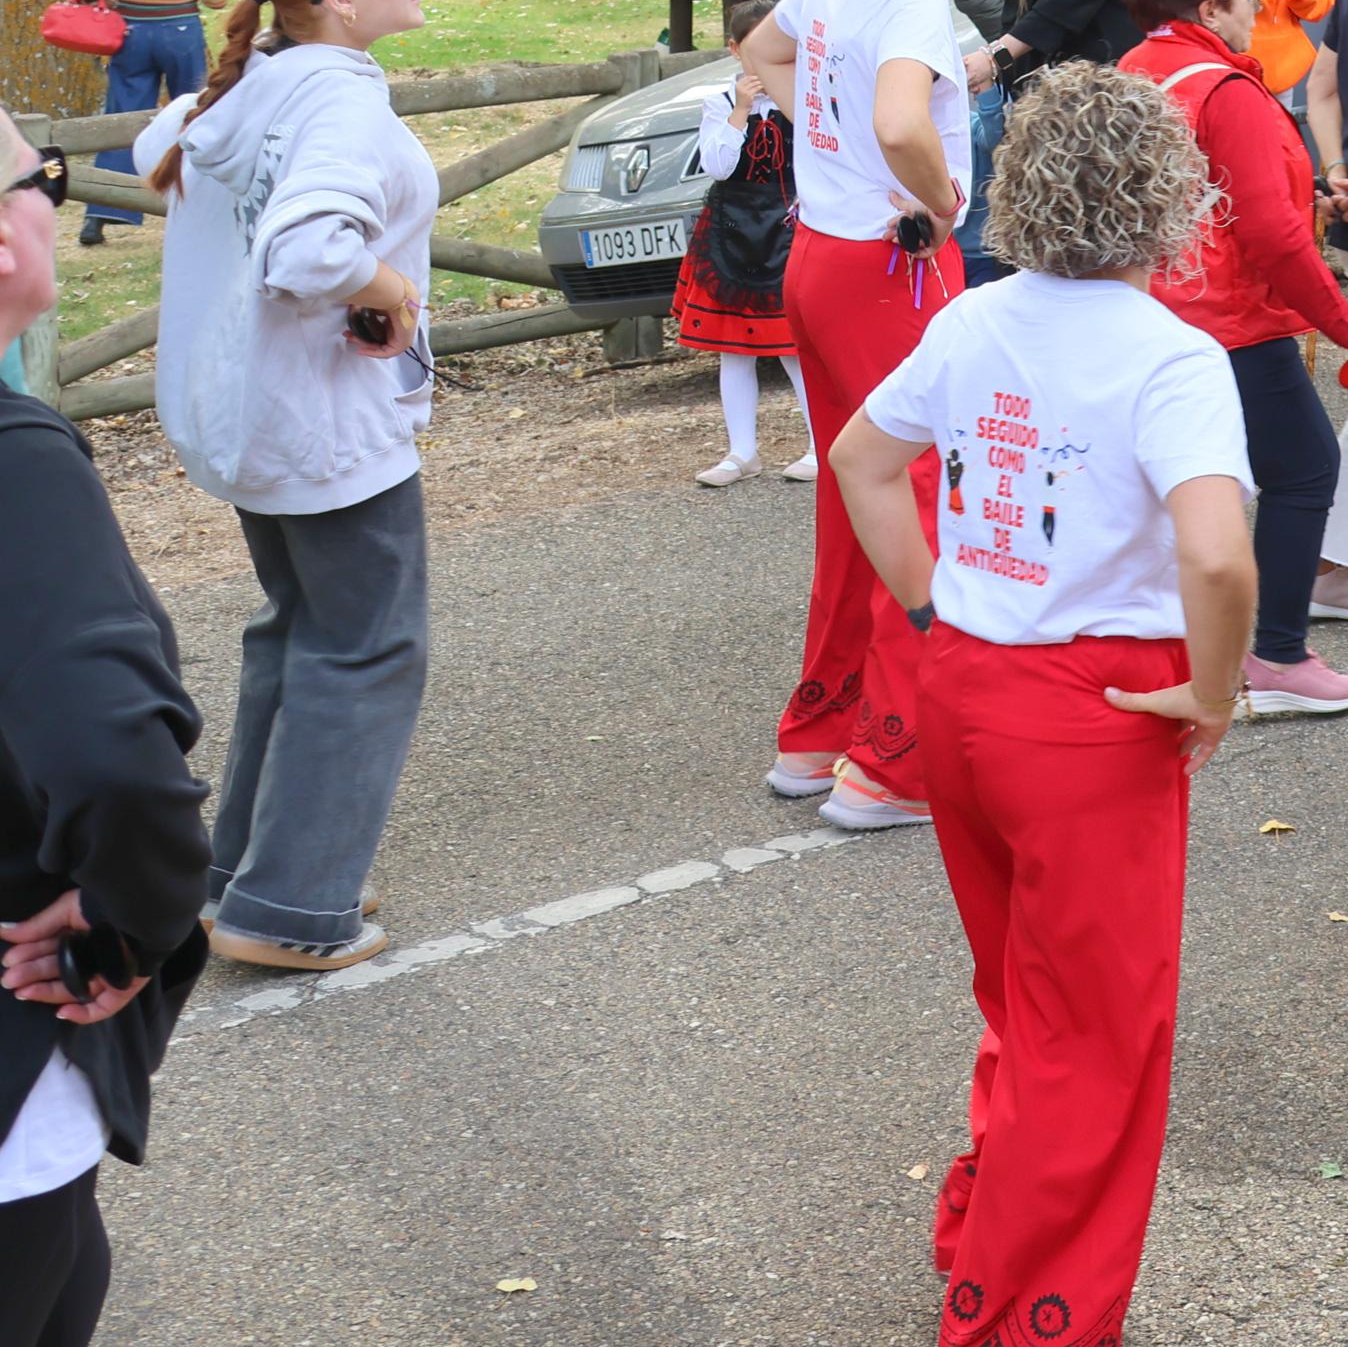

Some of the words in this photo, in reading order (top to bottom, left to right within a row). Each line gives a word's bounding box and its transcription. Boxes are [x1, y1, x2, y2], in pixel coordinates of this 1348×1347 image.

[809, 112, 820, 129] DE
[594, 230, 636, 261] 1093
[641, 223, 682, 256] DFK
[993, 392, 1031, 419] TODO
[976, 416, 1039, 449] SEGUIDO
[988, 445, 1025, 474] COMO
[997, 474, 1013, 498] EL
[983, 498, 1024, 528] BAILE
[993, 527, 1012, 552] DE
